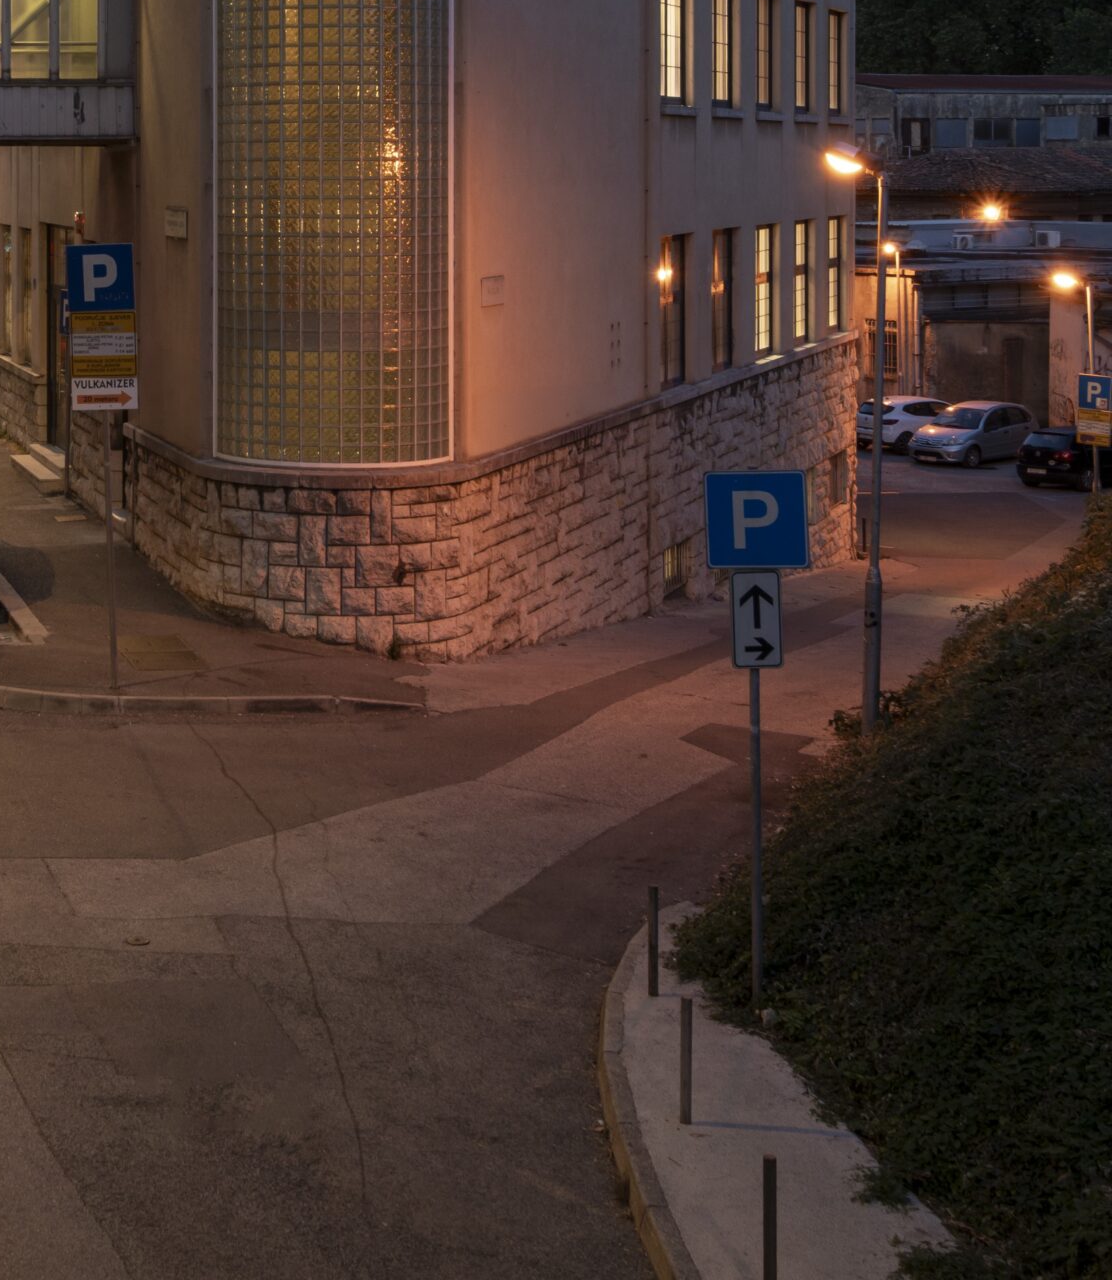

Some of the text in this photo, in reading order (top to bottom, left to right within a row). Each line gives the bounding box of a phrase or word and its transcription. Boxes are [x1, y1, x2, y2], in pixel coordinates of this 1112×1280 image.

[82, 254, 118, 302] P
[74, 379, 135, 389] VULKANIZER
[1087, 382, 1102, 402] P
[83, 395, 93, 403] 20
[732, 491, 779, 549] P
